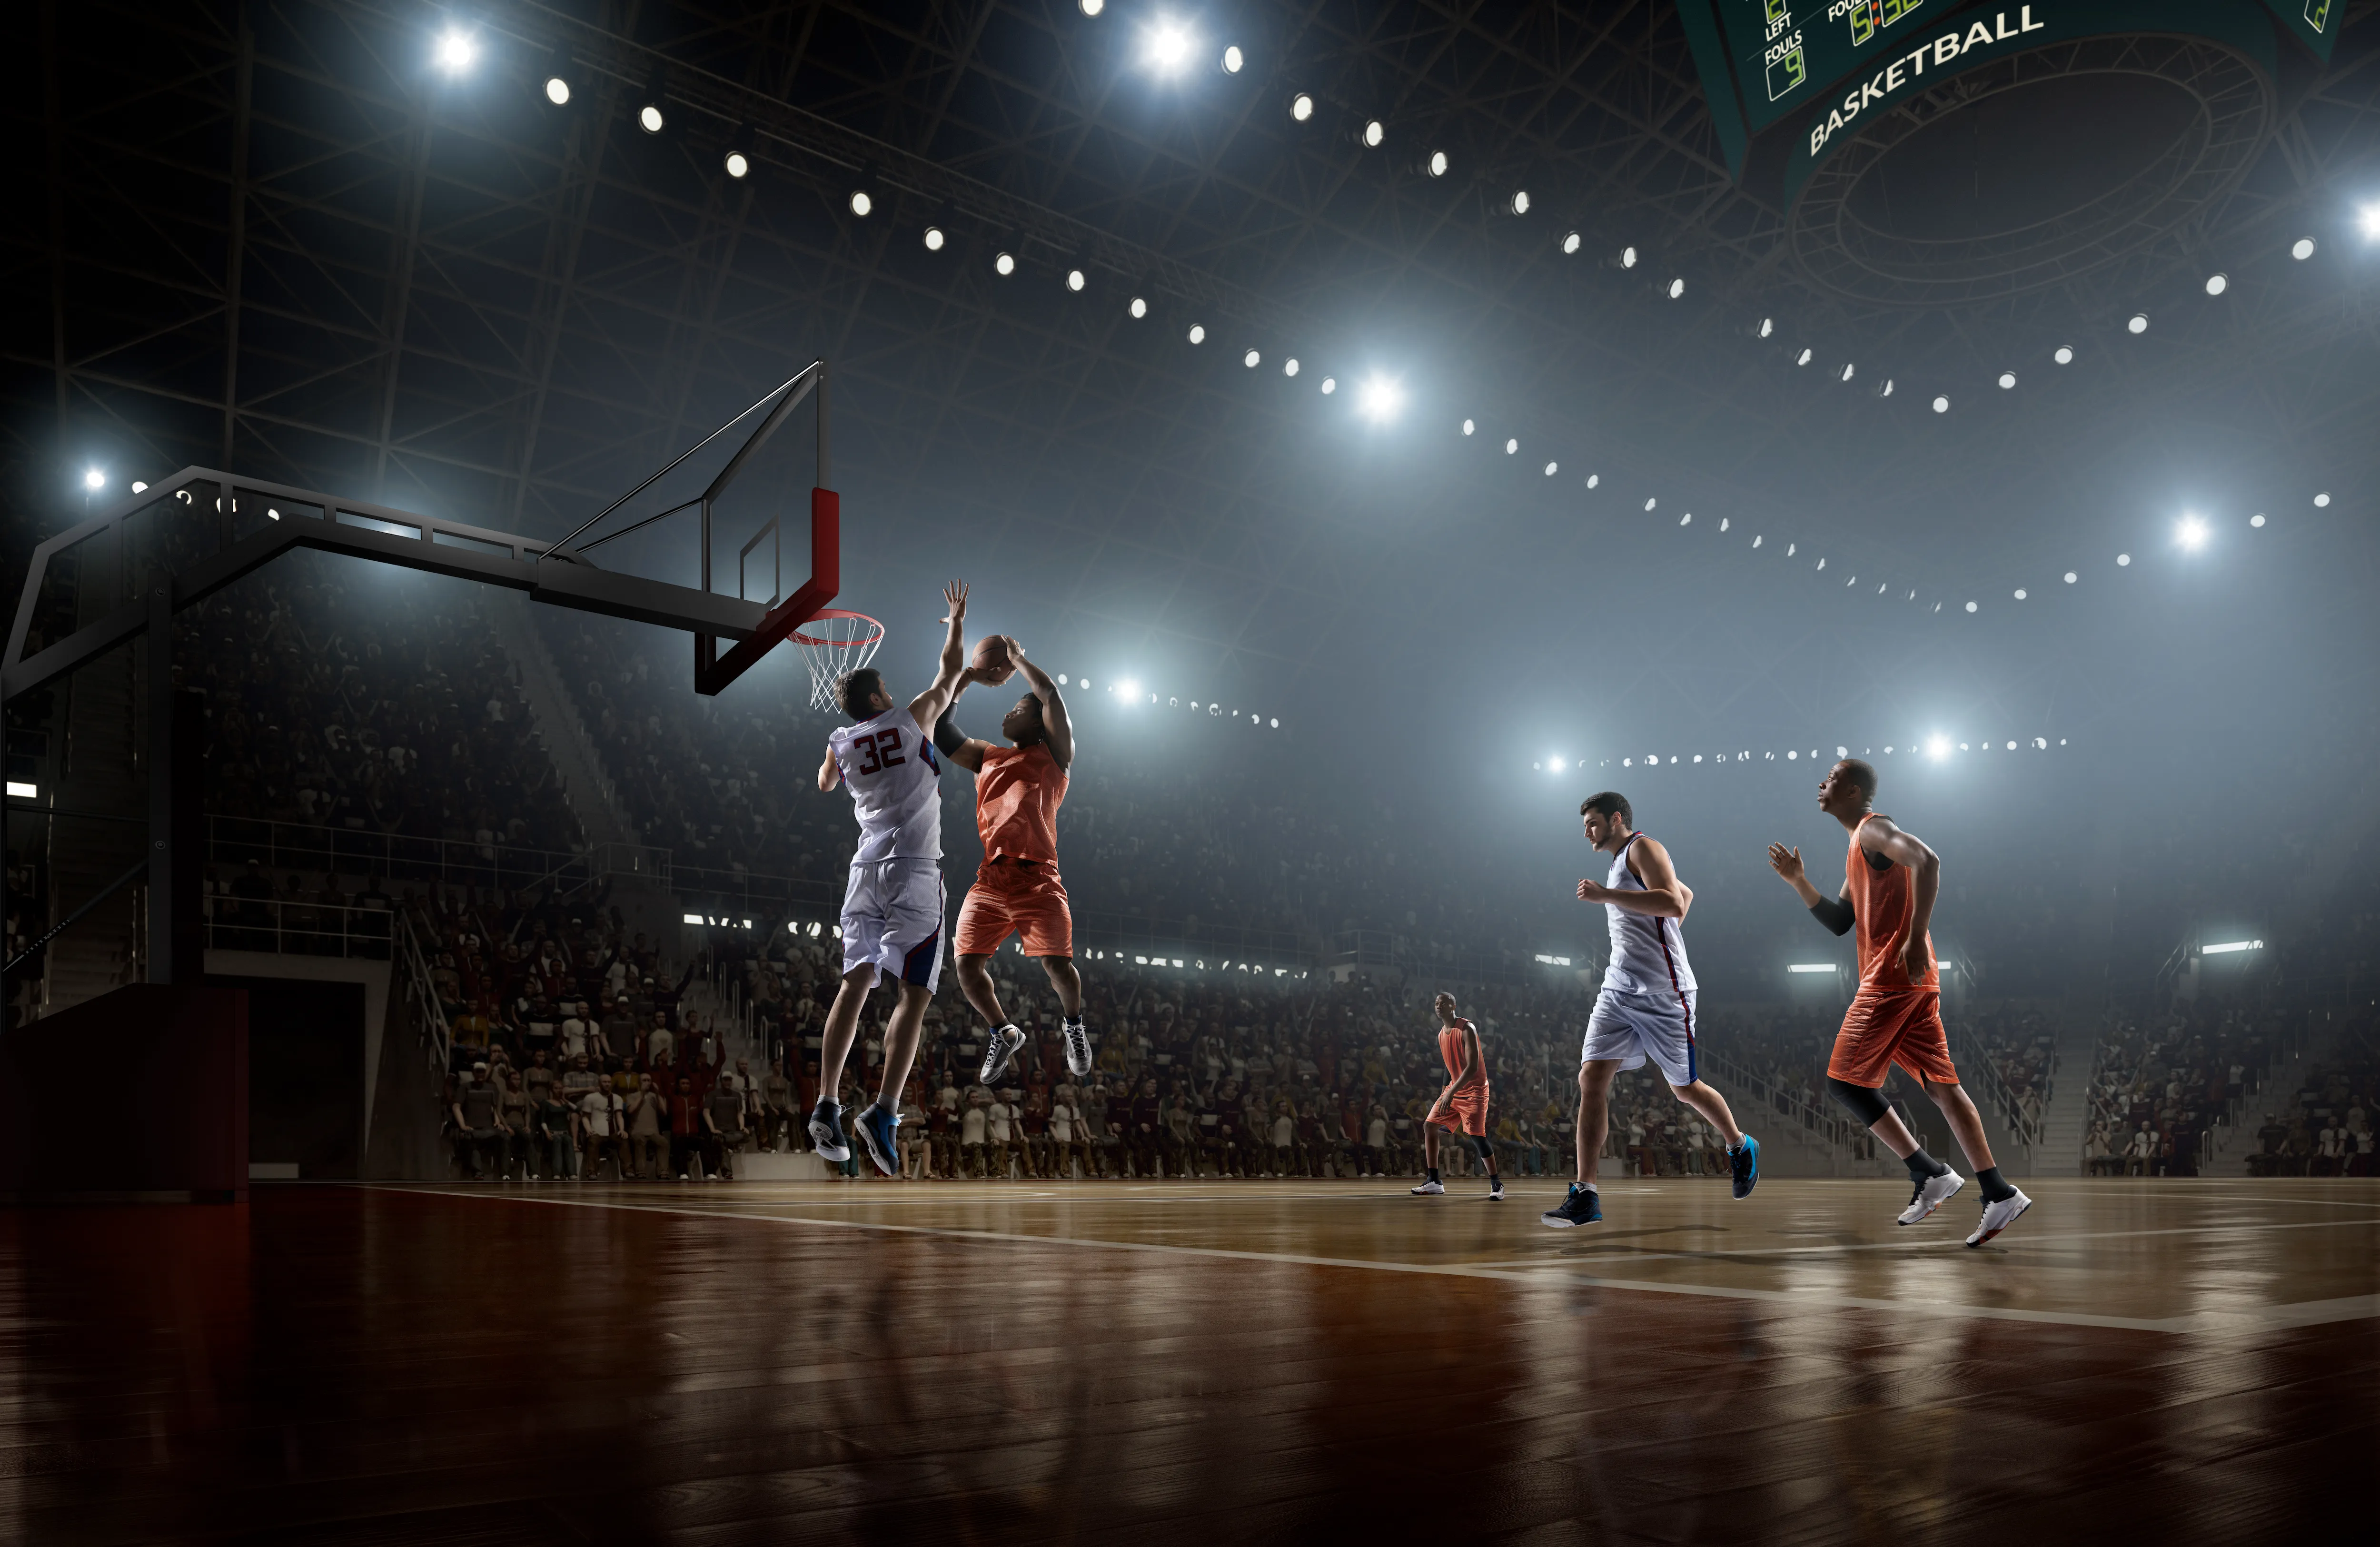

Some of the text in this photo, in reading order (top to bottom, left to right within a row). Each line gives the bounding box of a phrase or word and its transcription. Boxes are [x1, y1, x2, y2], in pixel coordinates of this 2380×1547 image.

[1765, 12, 1791, 41] LEFT
[1765, 30, 1802, 65] FOULS
[1785, 49, 1803, 87] 9
[1811, 5, 2044, 157] BASKETBALL
[853, 727, 906, 775] 32
